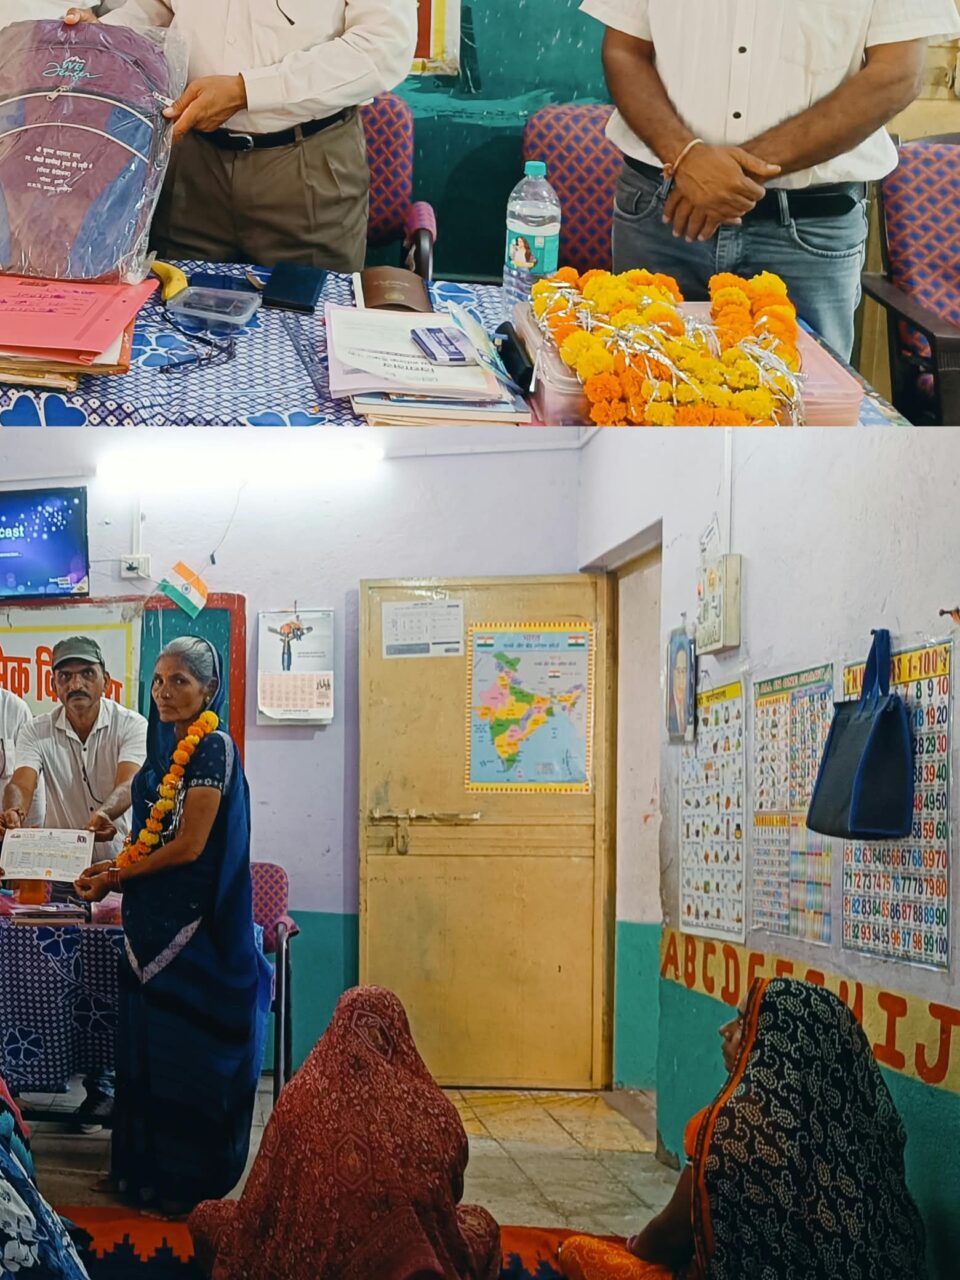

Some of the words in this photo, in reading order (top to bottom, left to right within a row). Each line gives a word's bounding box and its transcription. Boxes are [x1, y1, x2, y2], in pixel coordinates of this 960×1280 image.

[908, 650, 938, 679] 1-100
[915, 681, 922, 699] 8
[927, 679, 934, 697] 9
[936, 676, 948, 695] 10
[926, 707, 936, 725] 19
[936, 705, 947, 724] 20
[913, 736, 924, 755] 28
[925, 736, 936, 754] 29
[936, 734, 947, 752] 30
[924, 764, 935, 782] 39
[936, 763, 947, 782] 40
[924, 793, 935, 811] 49
[936, 793, 947, 811] 50
[912, 822, 922, 839] 58
[923, 821, 935, 839] 59
[935, 822, 947, 839] 60
[853, 847, 861, 863] 62
[862, 847, 872, 864] 63
[872, 848, 881, 865] 64
[882, 848, 890, 865] 65
[891, 849, 900, 866] 66
[901, 849, 912, 866] 67
[912, 849, 922, 867] 68
[923, 849, 935, 868] 69
[935, 850, 947, 869] 70
[844, 872, 852, 888] 71
[853, 872, 861, 889] 72
[862, 873, 871, 890] 73
[872, 874, 881, 891] 74
[882, 874, 890, 891] 75
[892, 876, 900, 893] 76
[901, 876, 912, 893] 77
[913, 877, 923, 895] 78
[924, 878, 935, 896] 79
[935, 879, 947, 897] 80
[852, 897, 860, 914] 82
[861, 899, 871, 916] 83
[872, 900, 881, 917] 84
[890, 903, 901, 920] 86
[901, 903, 912, 920] 87
[913, 905, 923, 923] 88
[924, 906, 935, 924] 89
[935, 908, 947, 926] 90
[852, 922, 859, 939] 92
[861, 924, 871, 941] 93
[872, 925, 880, 943] 94
[881, 927, 890, 945] 95
[891, 928, 901, 946] 96
[902, 931, 911, 949] 97
[912, 933, 923, 950] 98
[924, 935, 934, 952] 99
[935, 937, 947, 954] 100
